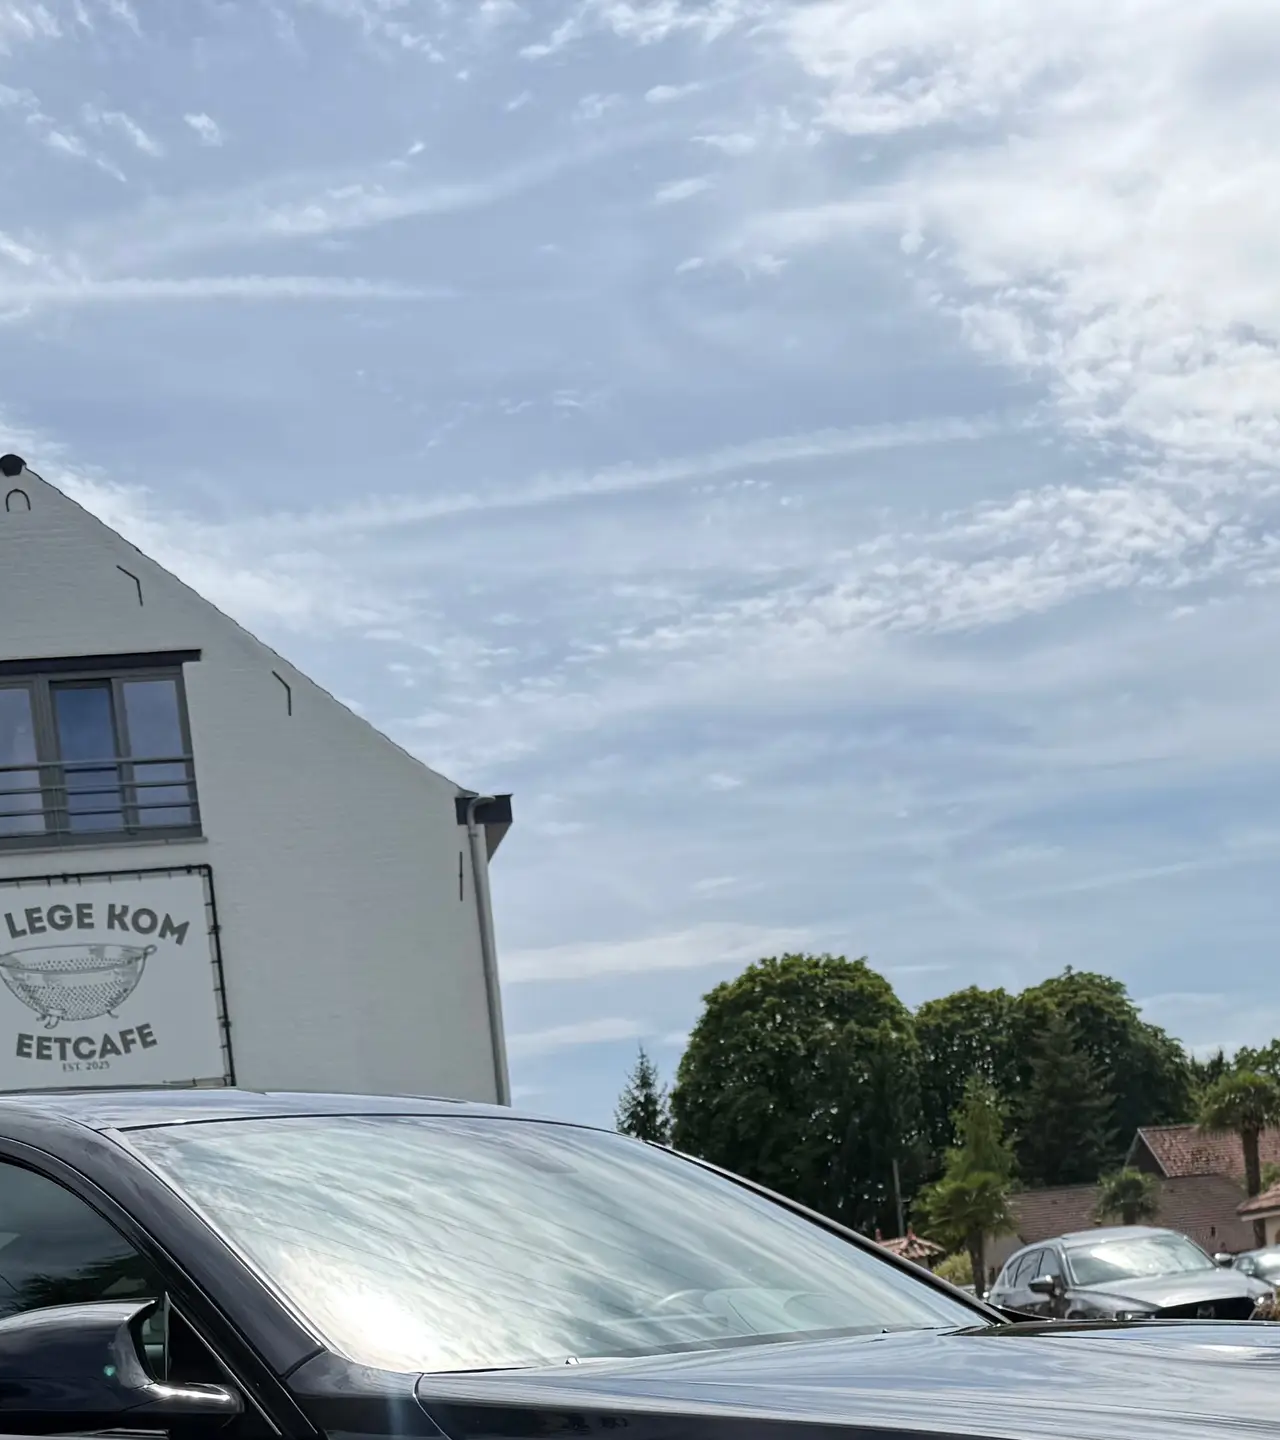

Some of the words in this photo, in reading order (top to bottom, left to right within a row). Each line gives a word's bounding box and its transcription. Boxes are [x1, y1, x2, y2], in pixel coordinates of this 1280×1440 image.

[4, 902, 95, 939] LEGE
[107, 903, 191, 946] KOM
[16, 1023, 158, 1062] EETCAFE
